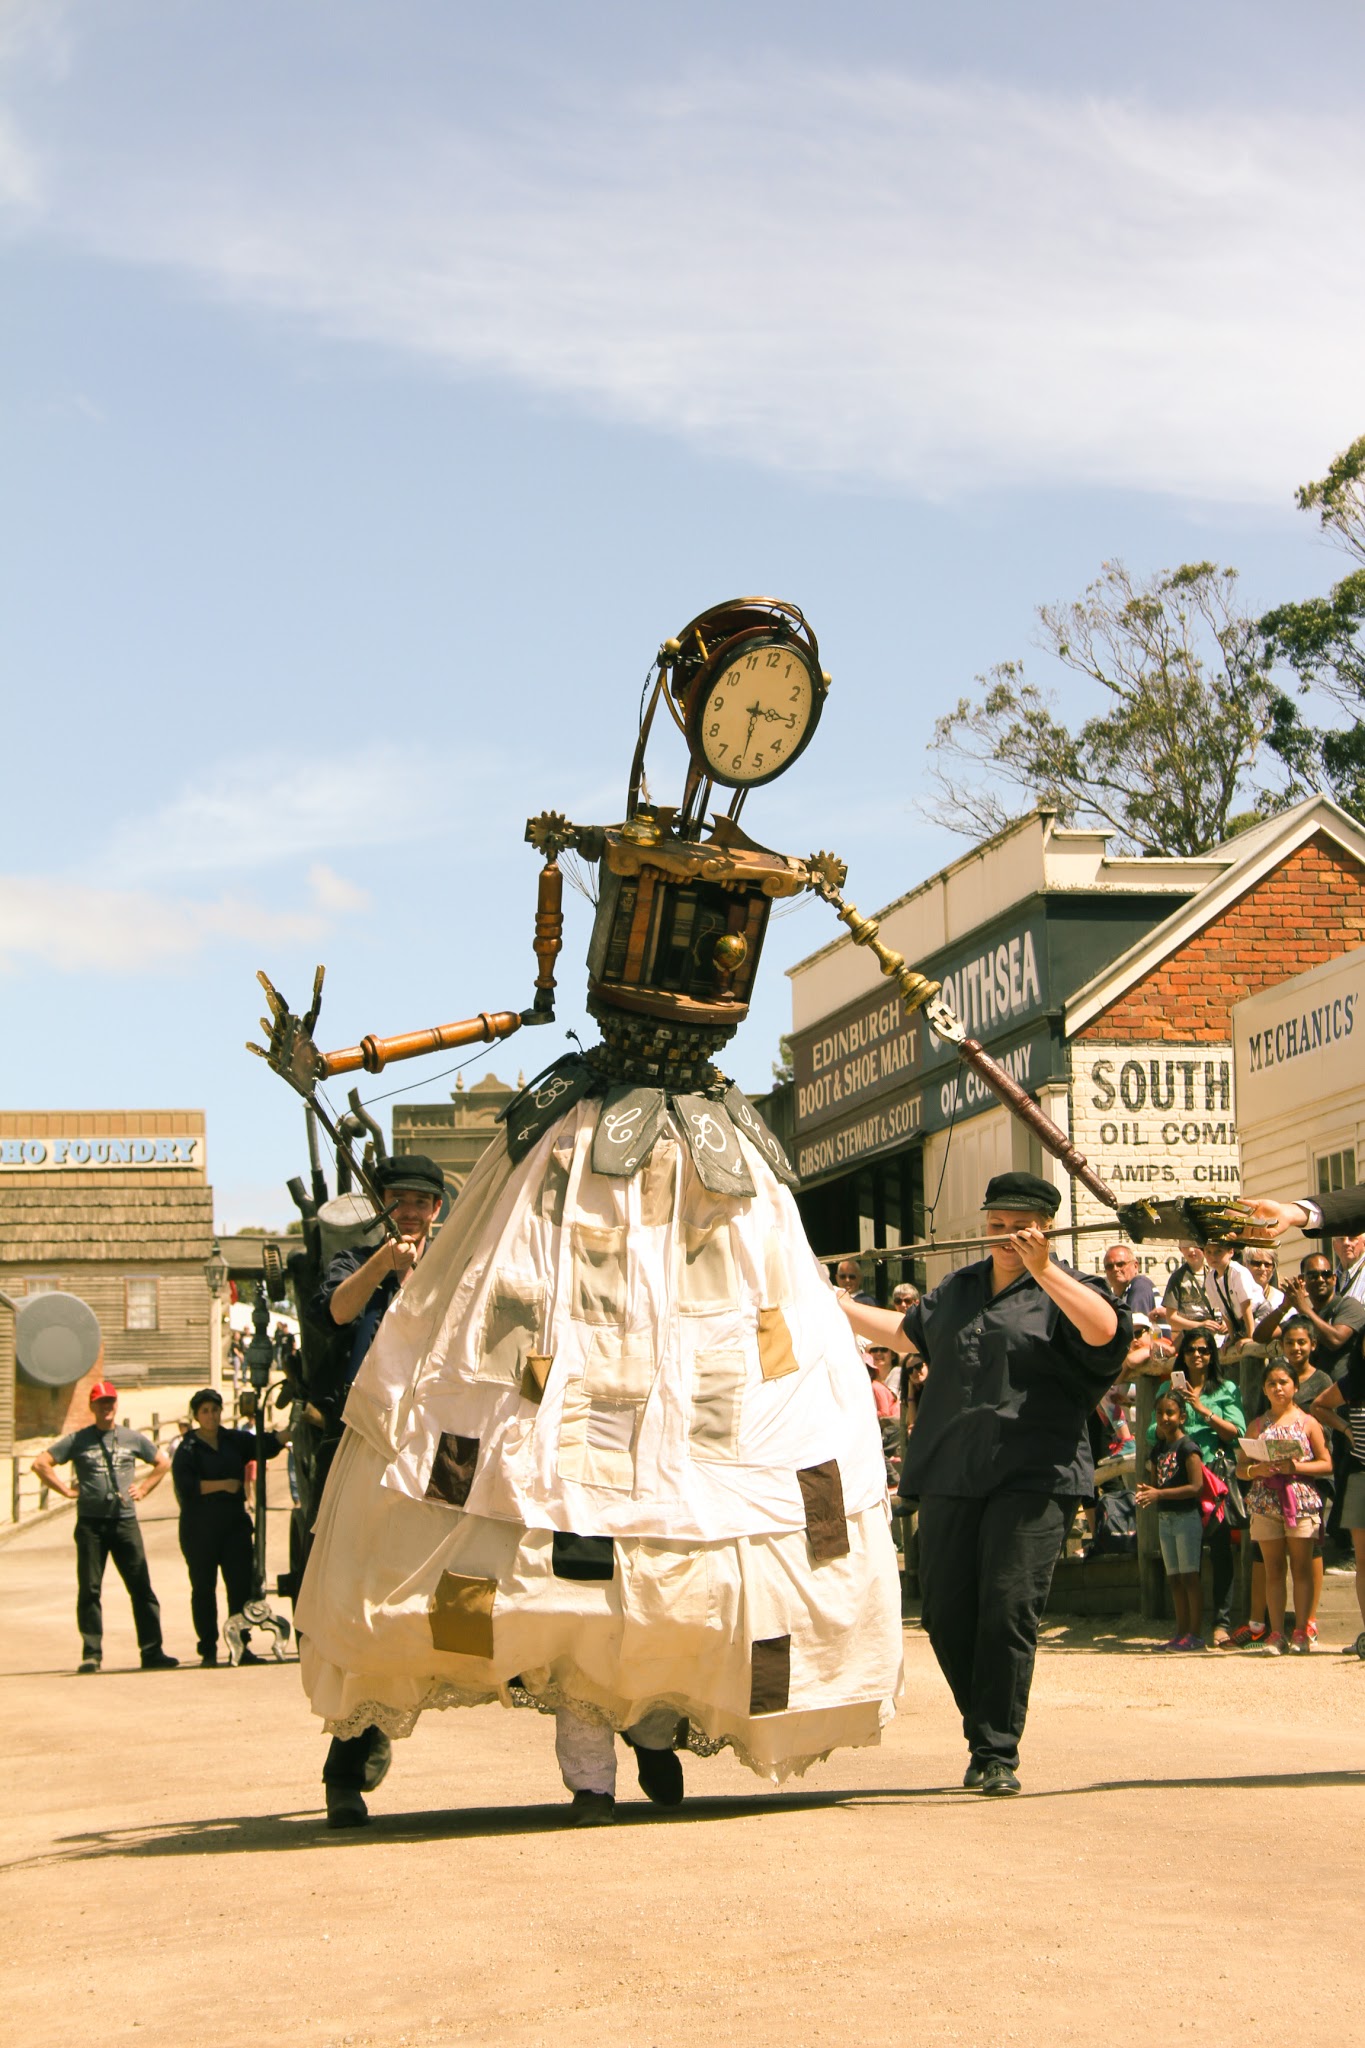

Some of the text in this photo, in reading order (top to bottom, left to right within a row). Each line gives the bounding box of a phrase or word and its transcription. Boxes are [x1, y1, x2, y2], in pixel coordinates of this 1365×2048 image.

[745, 655, 759, 671] 11
[765, 652, 781, 668] 12
[725, 671, 741, 686] 10
[784, 663, 793, 679] 1
[789, 685, 801, 702] 2
[714, 696, 725, 711] 9
[784, 712, 798, 729] 3
[709, 723, 720, 738] 8
[717, 743, 729, 758] 7
[769, 738, 783, 754] 4
[731, 754, 743, 770] 6
[751, 752, 764, 768] 5
[812, 998, 900, 1073] EDINBURGH
[1248, 992, 1360, 1074] MECHANICS'
[799, 1029, 917, 1120] BOOT & SHOE MART
[1091, 1059, 1230, 1113] SOUTH
[940, 1078, 963, 1118] OIL
[799, 1096, 922, 1178] GIBSON STEWART & SCOTT
[1100, 1122, 1149, 1145] OIL
[0, 1138, 197, 1165] HO FOUNDRY
